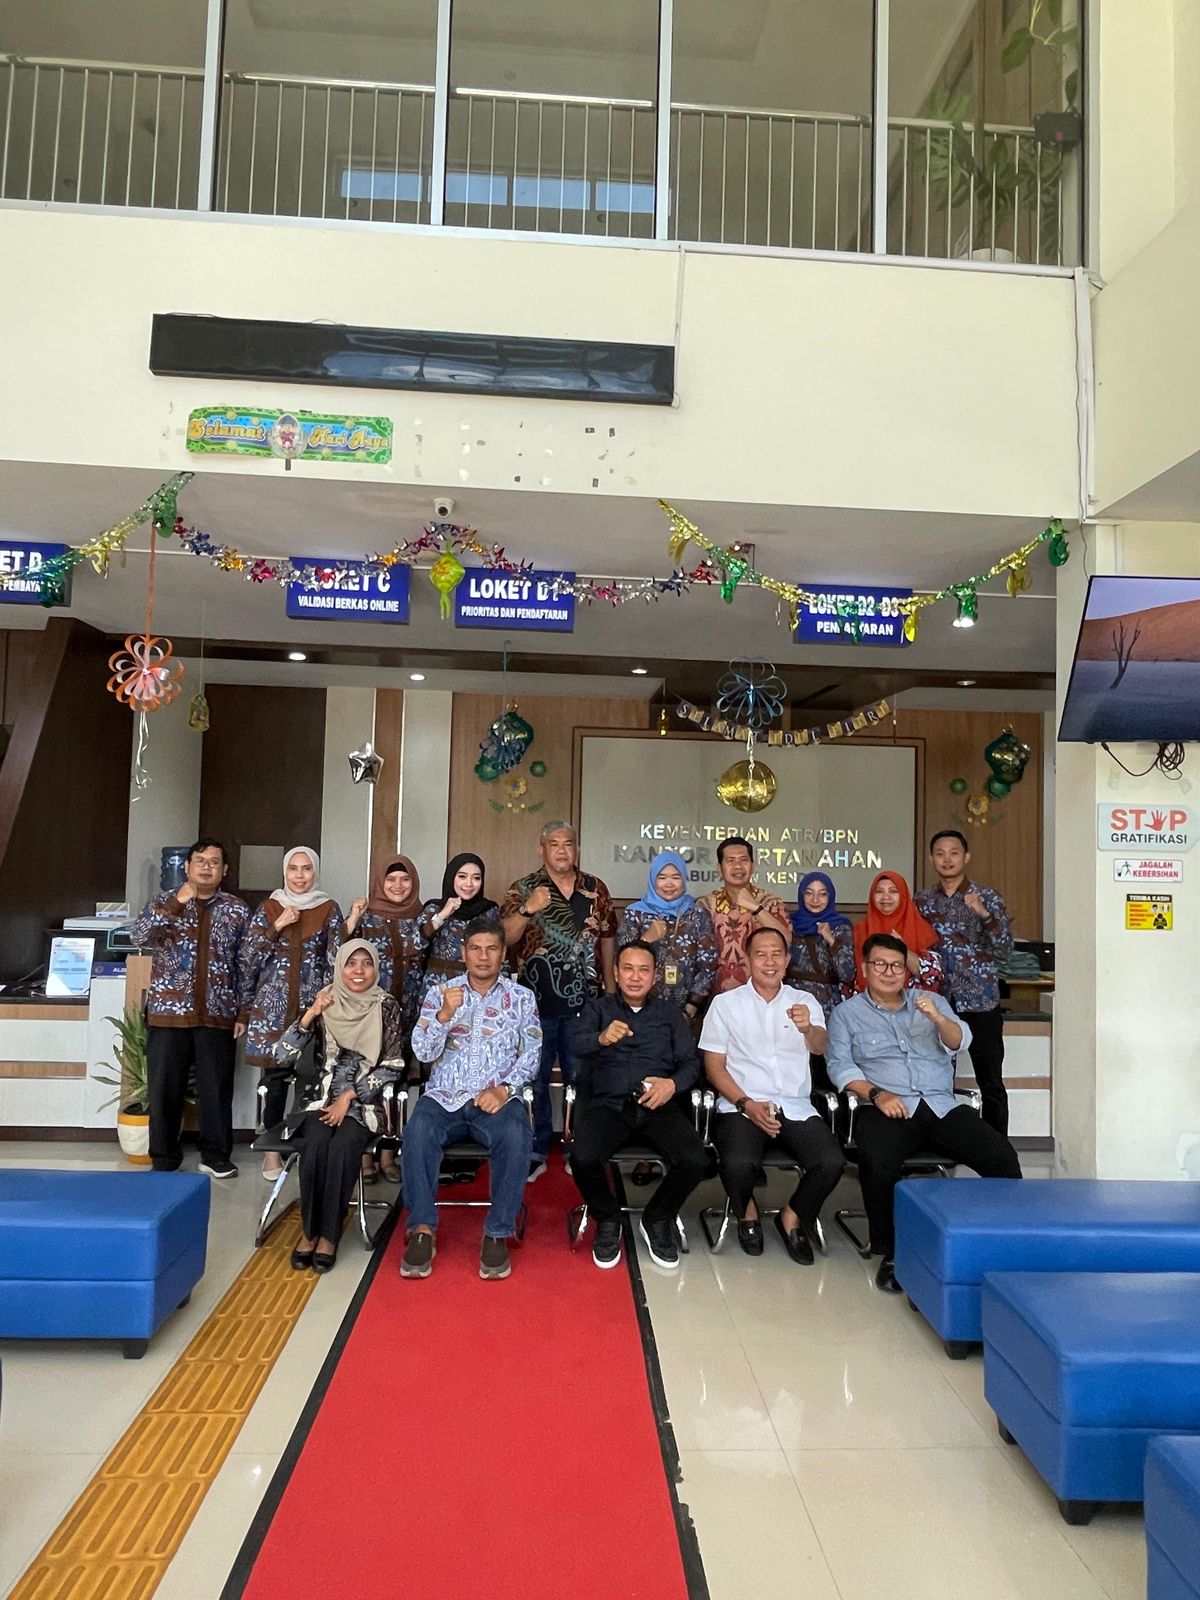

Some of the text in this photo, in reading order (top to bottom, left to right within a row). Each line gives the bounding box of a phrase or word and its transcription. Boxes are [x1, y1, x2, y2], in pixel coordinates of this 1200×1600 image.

[189, 418, 266, 440] Selamat
[309, 427, 346, 446] Hari
[377, 570, 391, 593] C
[470, 579, 531, 600] LOKET
[298, 595, 399, 612] VALIDASI BERKAS ONLINE
[461, 605, 568, 620] PRIORITAS DAN PENDAFTARAN
[641, 823, 859, 845] KEMENTERIAN ATR/BPN
[1111, 833, 1187, 845] GRATIFIKASI
[613, 844, 882, 869] KANOR RTANAHAN
[1139, 861, 1173, 869] JAGALAH
[1133, 870, 1179, 878] KEBERSIHAN
